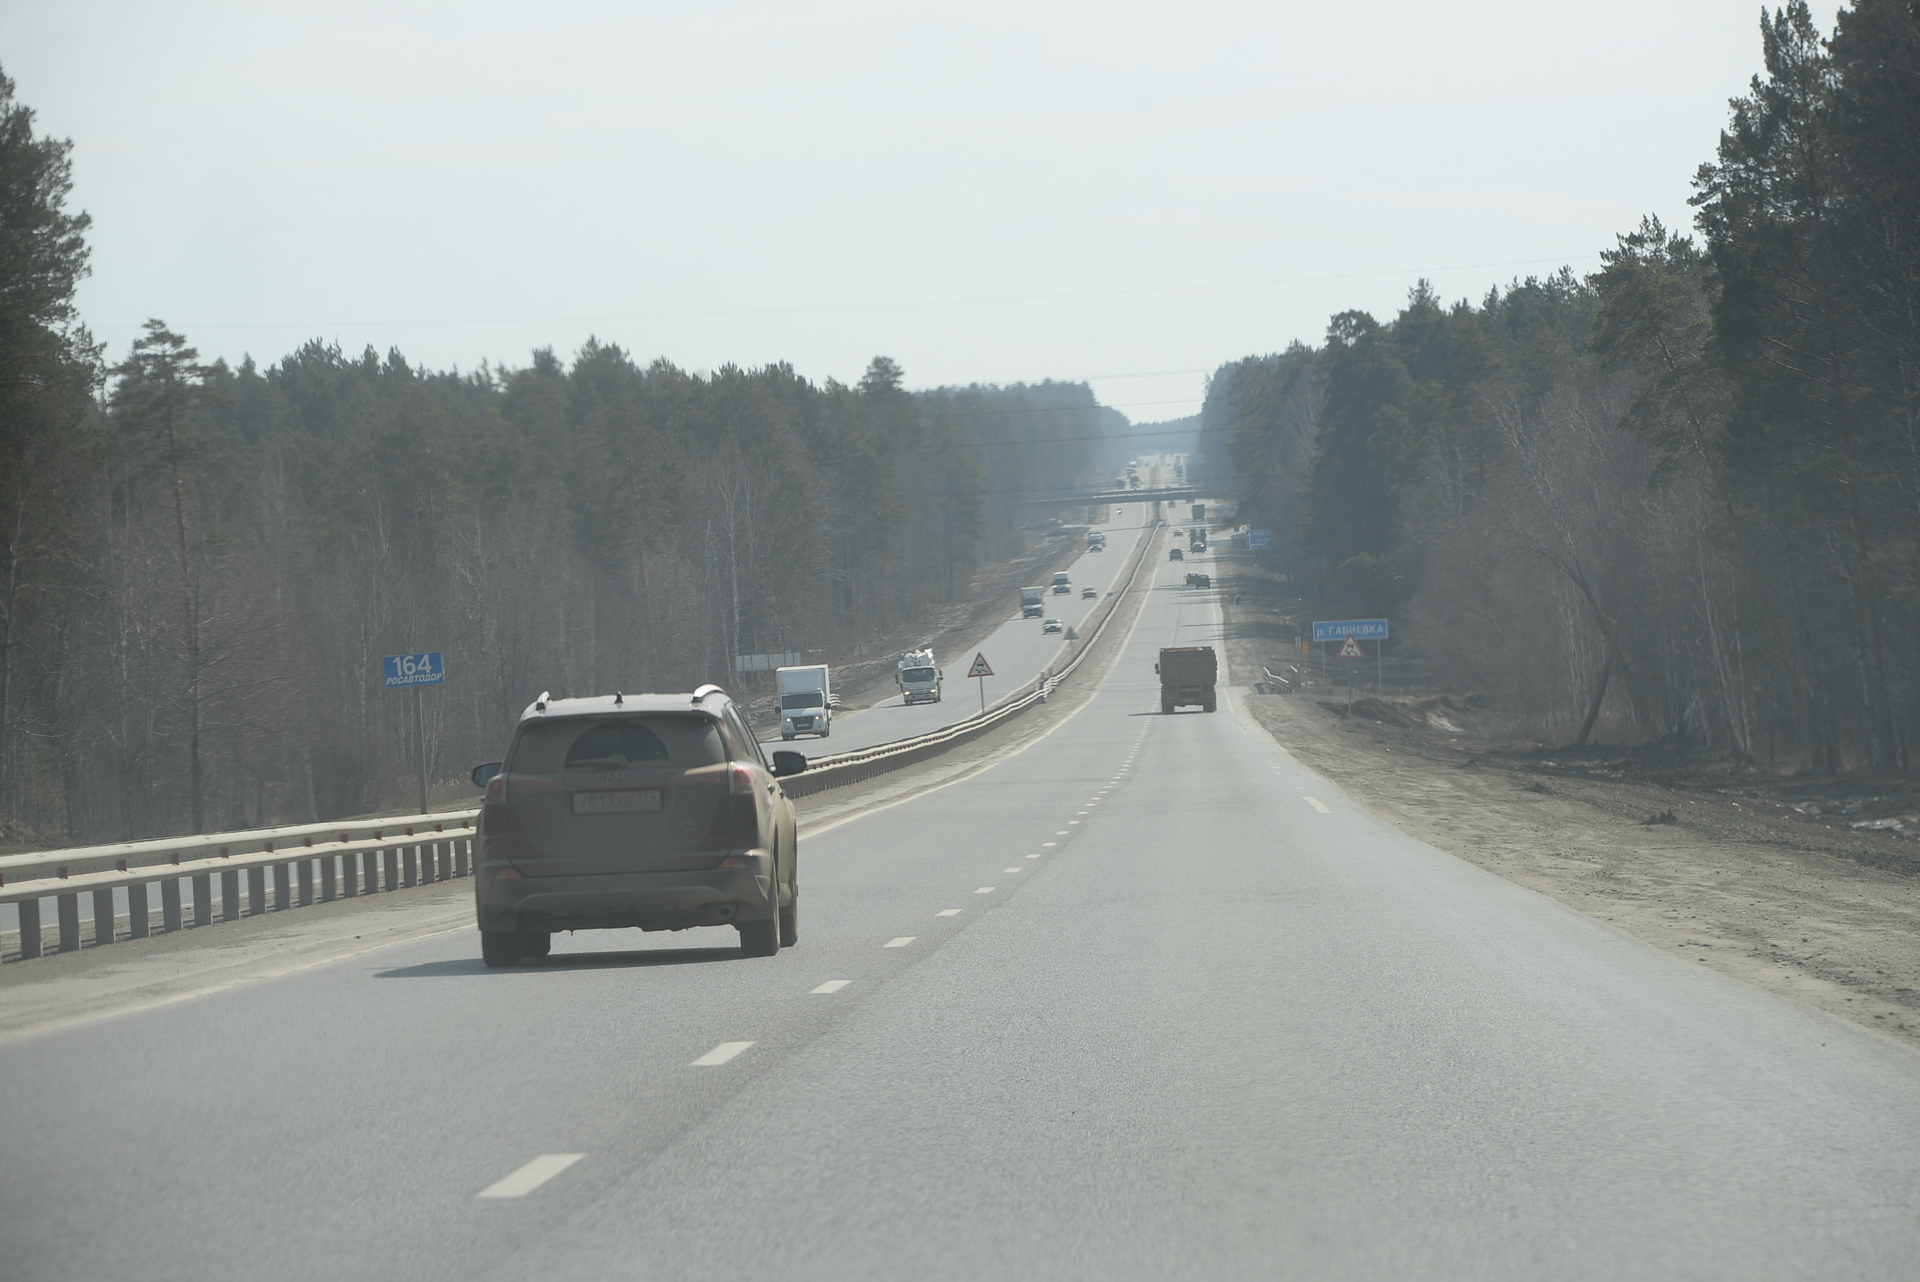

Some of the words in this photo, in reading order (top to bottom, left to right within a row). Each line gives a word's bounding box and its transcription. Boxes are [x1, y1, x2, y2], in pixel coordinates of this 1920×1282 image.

[1328, 624, 1384, 636] ГАБИЕВКА
[393, 654, 432, 676] 164
[386, 673, 442, 685] РОСАВТОДОР
